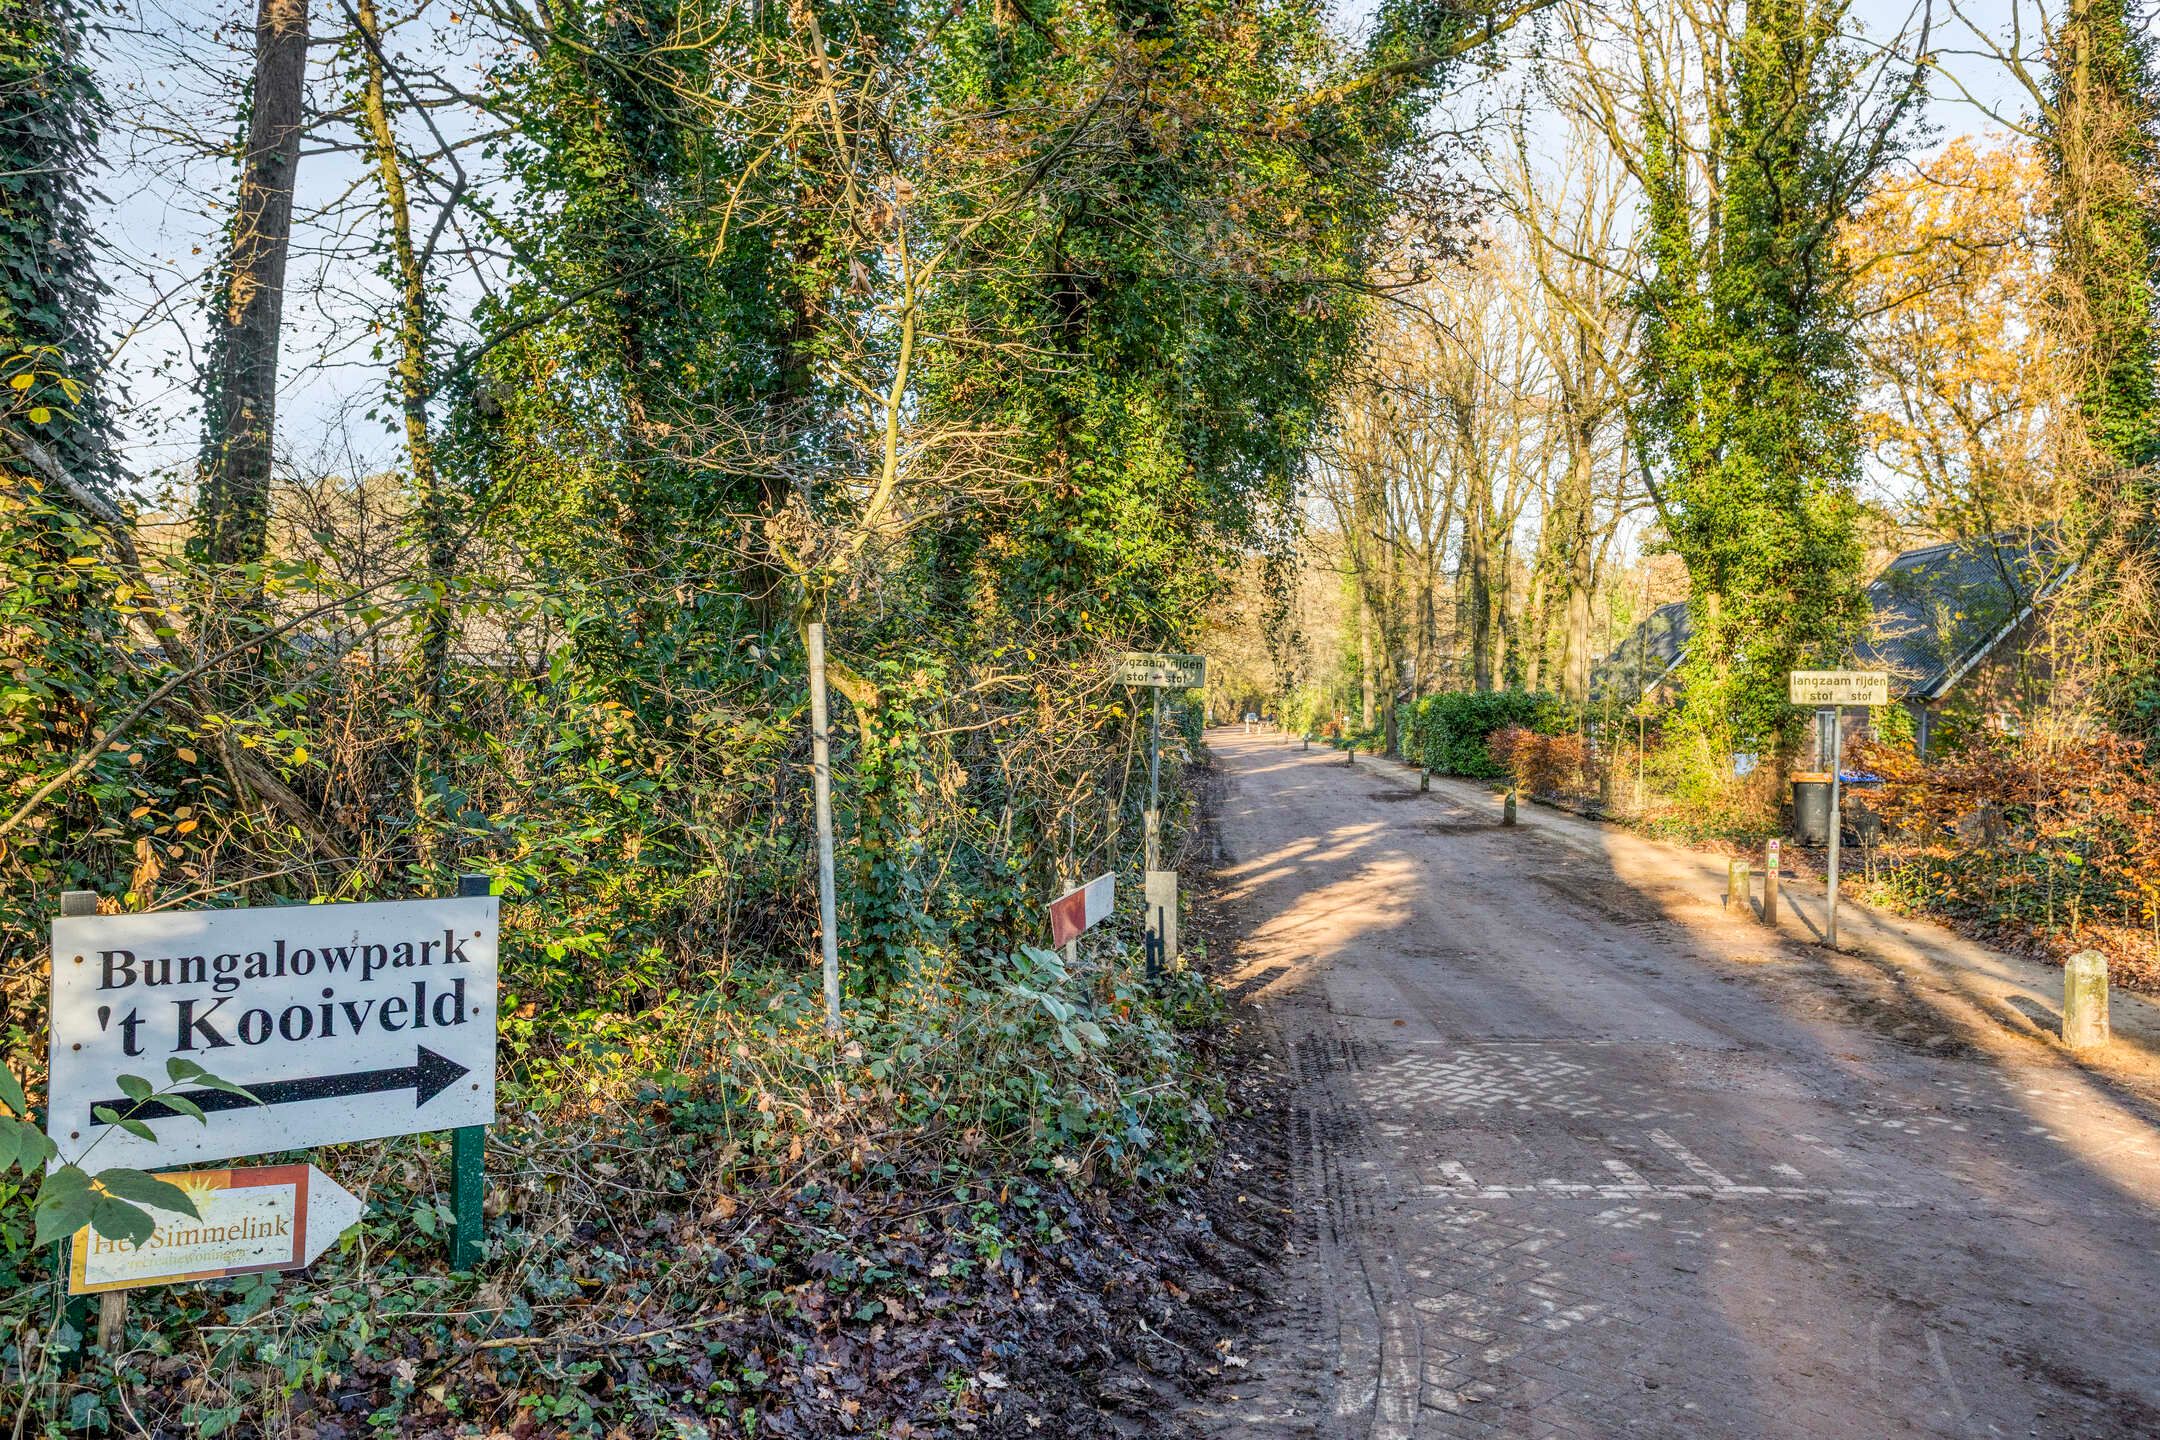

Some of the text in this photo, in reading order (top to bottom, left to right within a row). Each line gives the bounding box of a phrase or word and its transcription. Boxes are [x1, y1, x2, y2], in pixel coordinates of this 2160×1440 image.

[1170, 659, 1203, 670] rijden
[1126, 672, 1187, 683] stof stof
[1793, 675, 1886, 688] langzaam rijden
[1810, 691, 1872, 701] stof stof
[96, 928, 470, 993] Bungalowpark
[97, 977, 469, 1057] 't Kooiveld
[93, 1214, 290, 1255] He Simmelink
